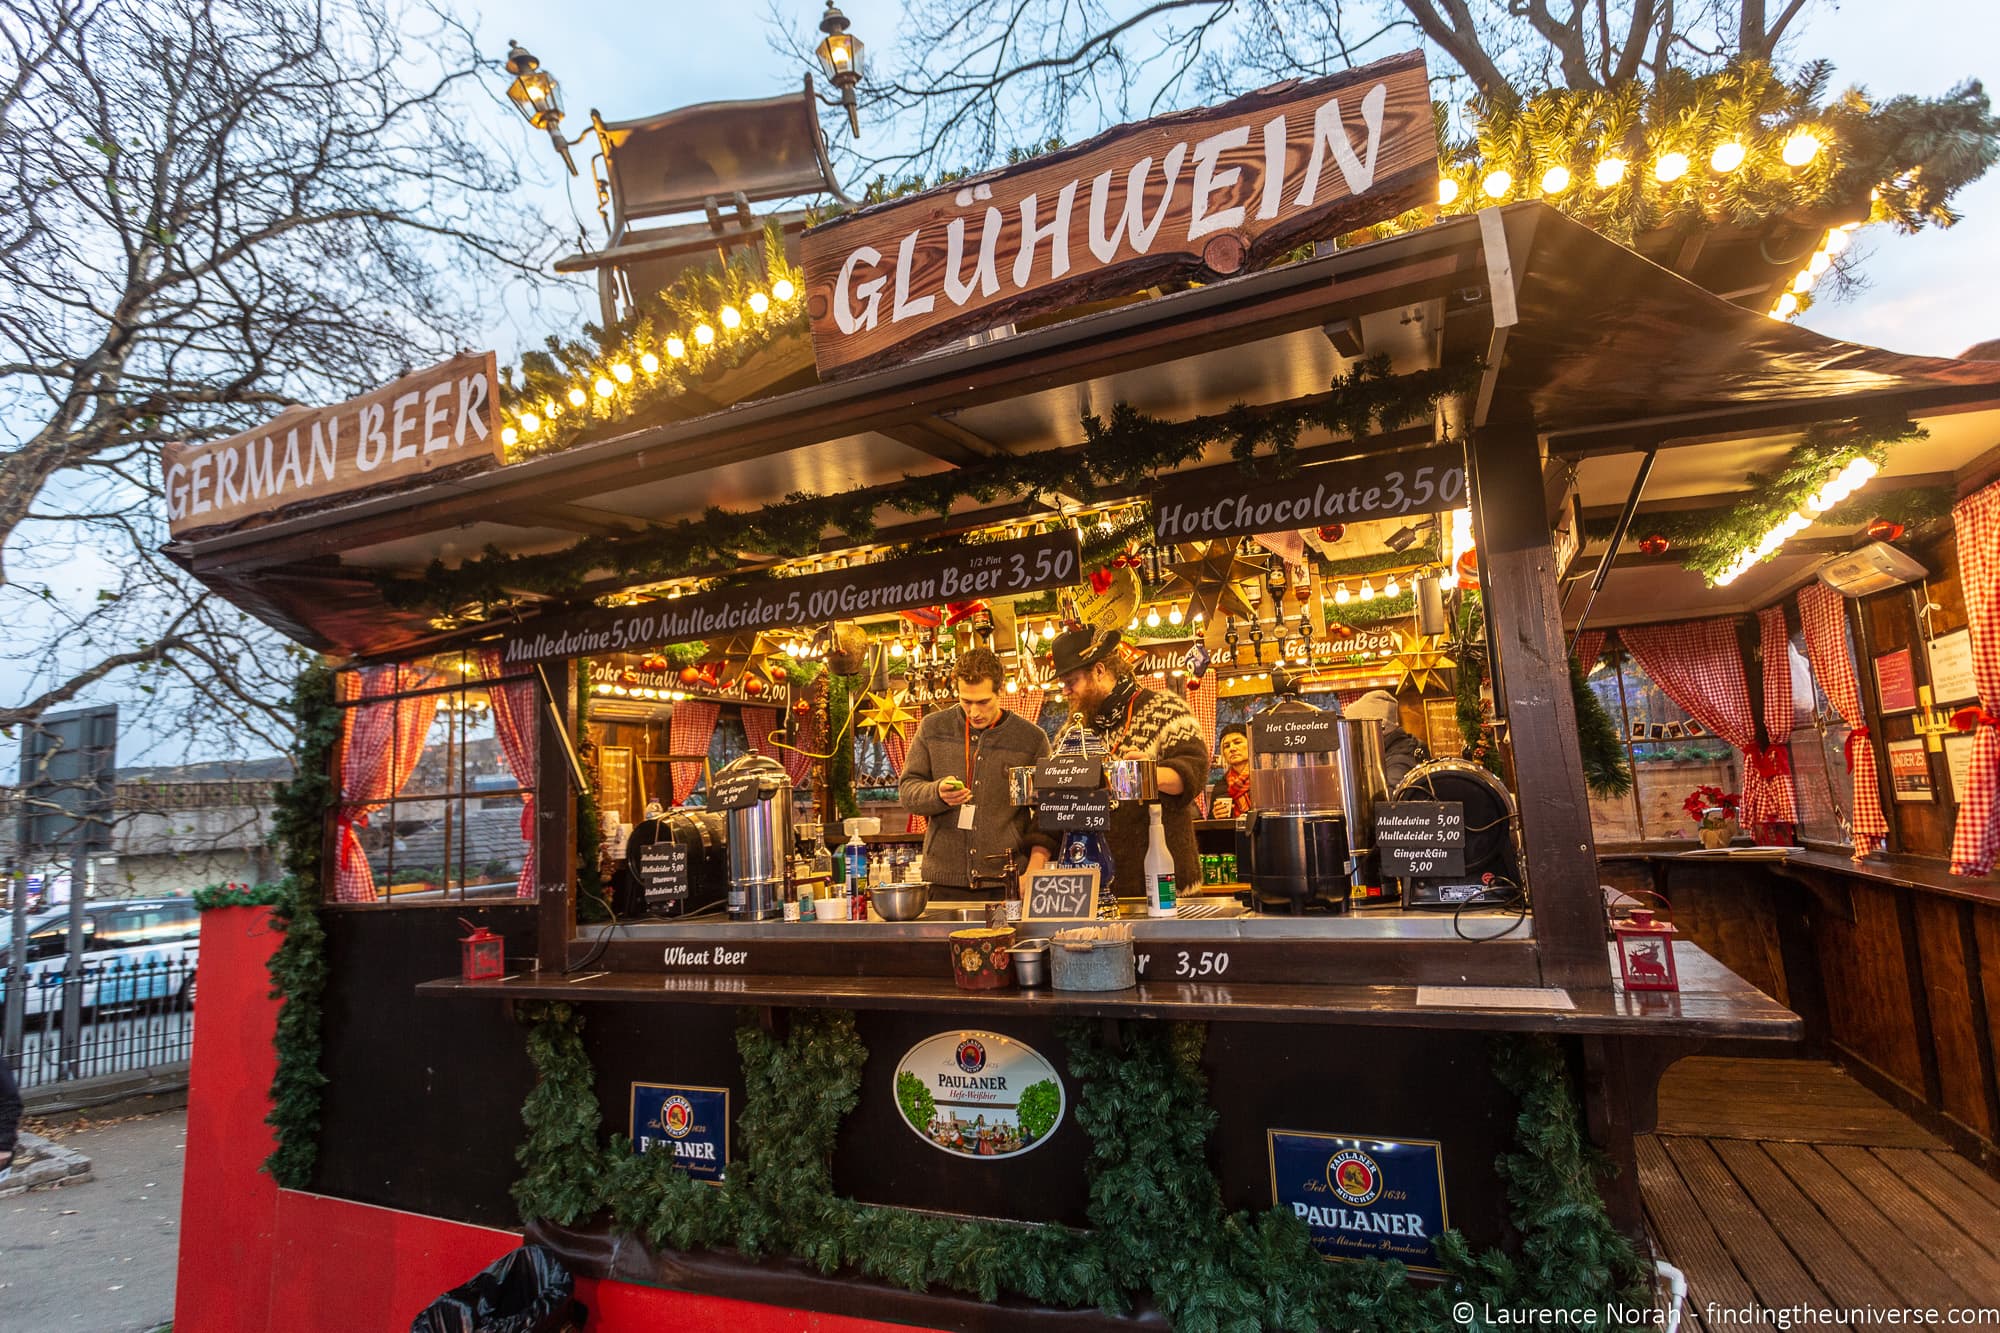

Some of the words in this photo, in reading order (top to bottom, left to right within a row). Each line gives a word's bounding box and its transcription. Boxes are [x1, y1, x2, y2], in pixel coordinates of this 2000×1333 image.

[832, 84, 1388, 336] GLÜHWEIN
[165, 415, 338, 521] GERMAN
[355, 372, 490, 472] BEER
[839, 577, 935, 612] German
[940, 566, 1002, 598] Beer
[1008, 547, 1073, 589] 3,50
[1266, 723, 1282, 732] Hot
[1284, 721, 1329, 731] Chocolate
[1283, 735, 1307, 746] 3,50
[1045, 766, 1069, 775] Wheat
[1071, 766, 1089, 775] Beer
[1040, 802, 1069, 811] German
[1071, 803, 1105, 811] Paulaner
[1057, 812, 1075, 821] Beer
[1085, 816, 1105, 827] 3,50
[1377, 815, 1430, 826] Mulledwine
[1437, 814, 1460, 827] 5,00
[1378, 830, 1434, 841] Mulledcider
[1437, 830, 1460, 843] 5,00
[1393, 848, 1448, 860] Ginger&Gin
[1409, 861, 1433, 873] 5,00
[1034, 876, 1084, 894] CASH
[1032, 893, 1087, 916] ONLY
[664, 946, 710, 966] Wheat
[713, 946, 748, 965] Beer
[1175, 951, 1229, 978] 3,50
[938, 1073, 1008, 1091] PAULANER
[640, 1136, 716, 1160] PANER
[1330, 1152, 1377, 1174] PAULANER
[1292, 1201, 1428, 1239] PAULANER
